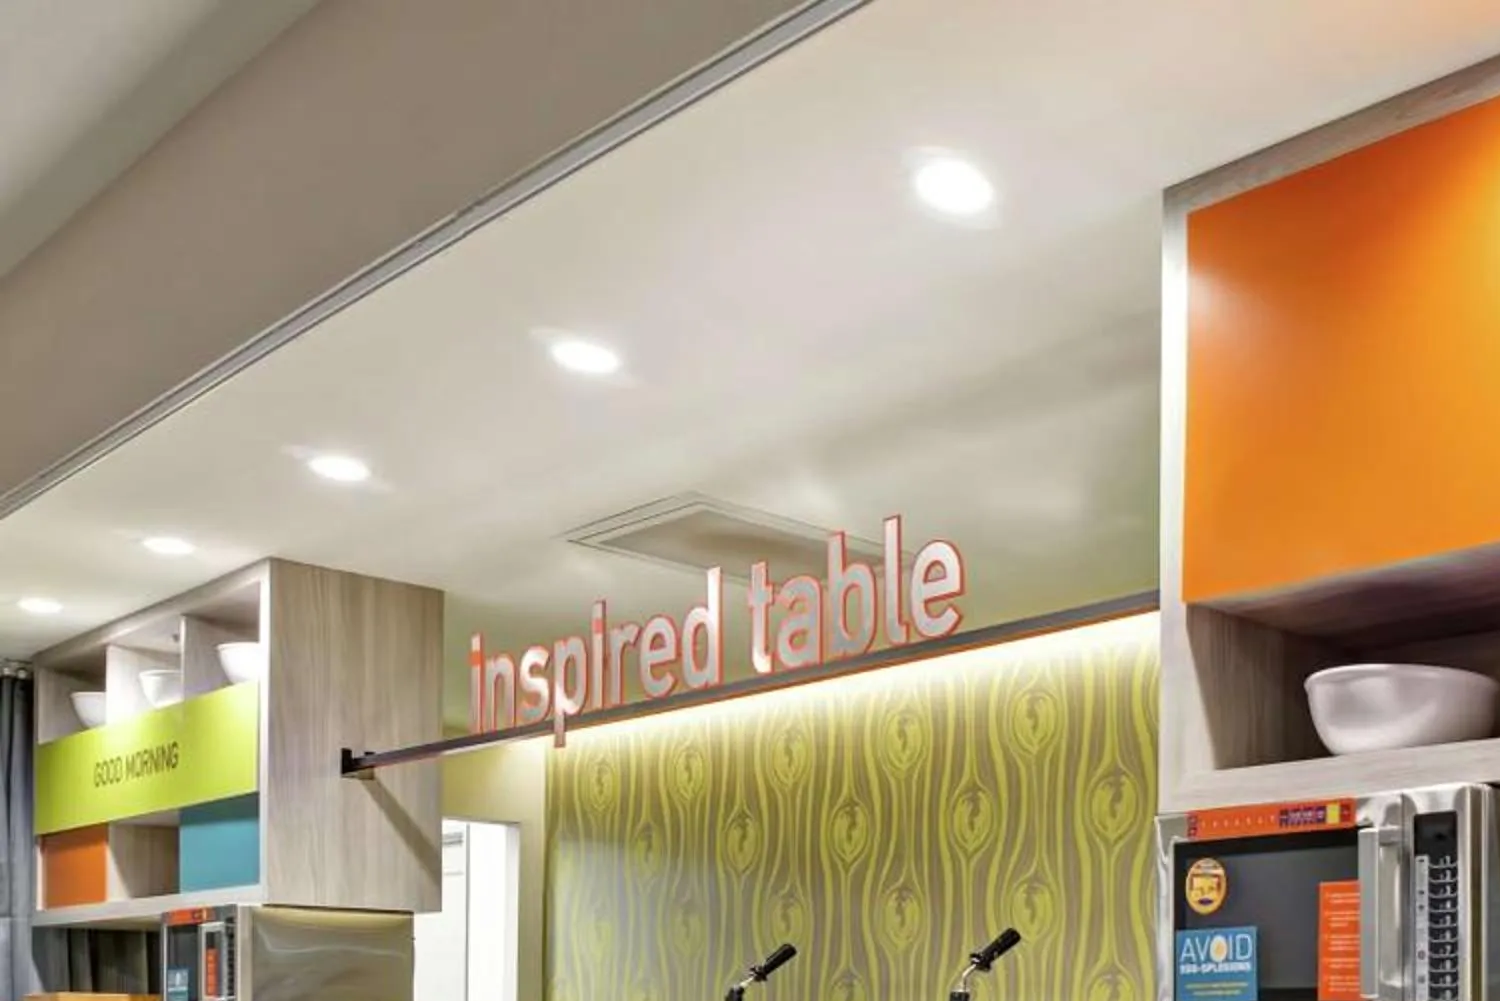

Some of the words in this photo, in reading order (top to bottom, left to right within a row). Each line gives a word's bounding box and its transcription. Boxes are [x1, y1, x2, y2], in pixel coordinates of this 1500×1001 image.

[468, 565, 722, 748] inspired
[747, 514, 964, 674] table
[94, 757, 123, 787] GOOD
[126, 741, 178, 780] MORNING
[1179, 933, 1253, 962] AVOID
